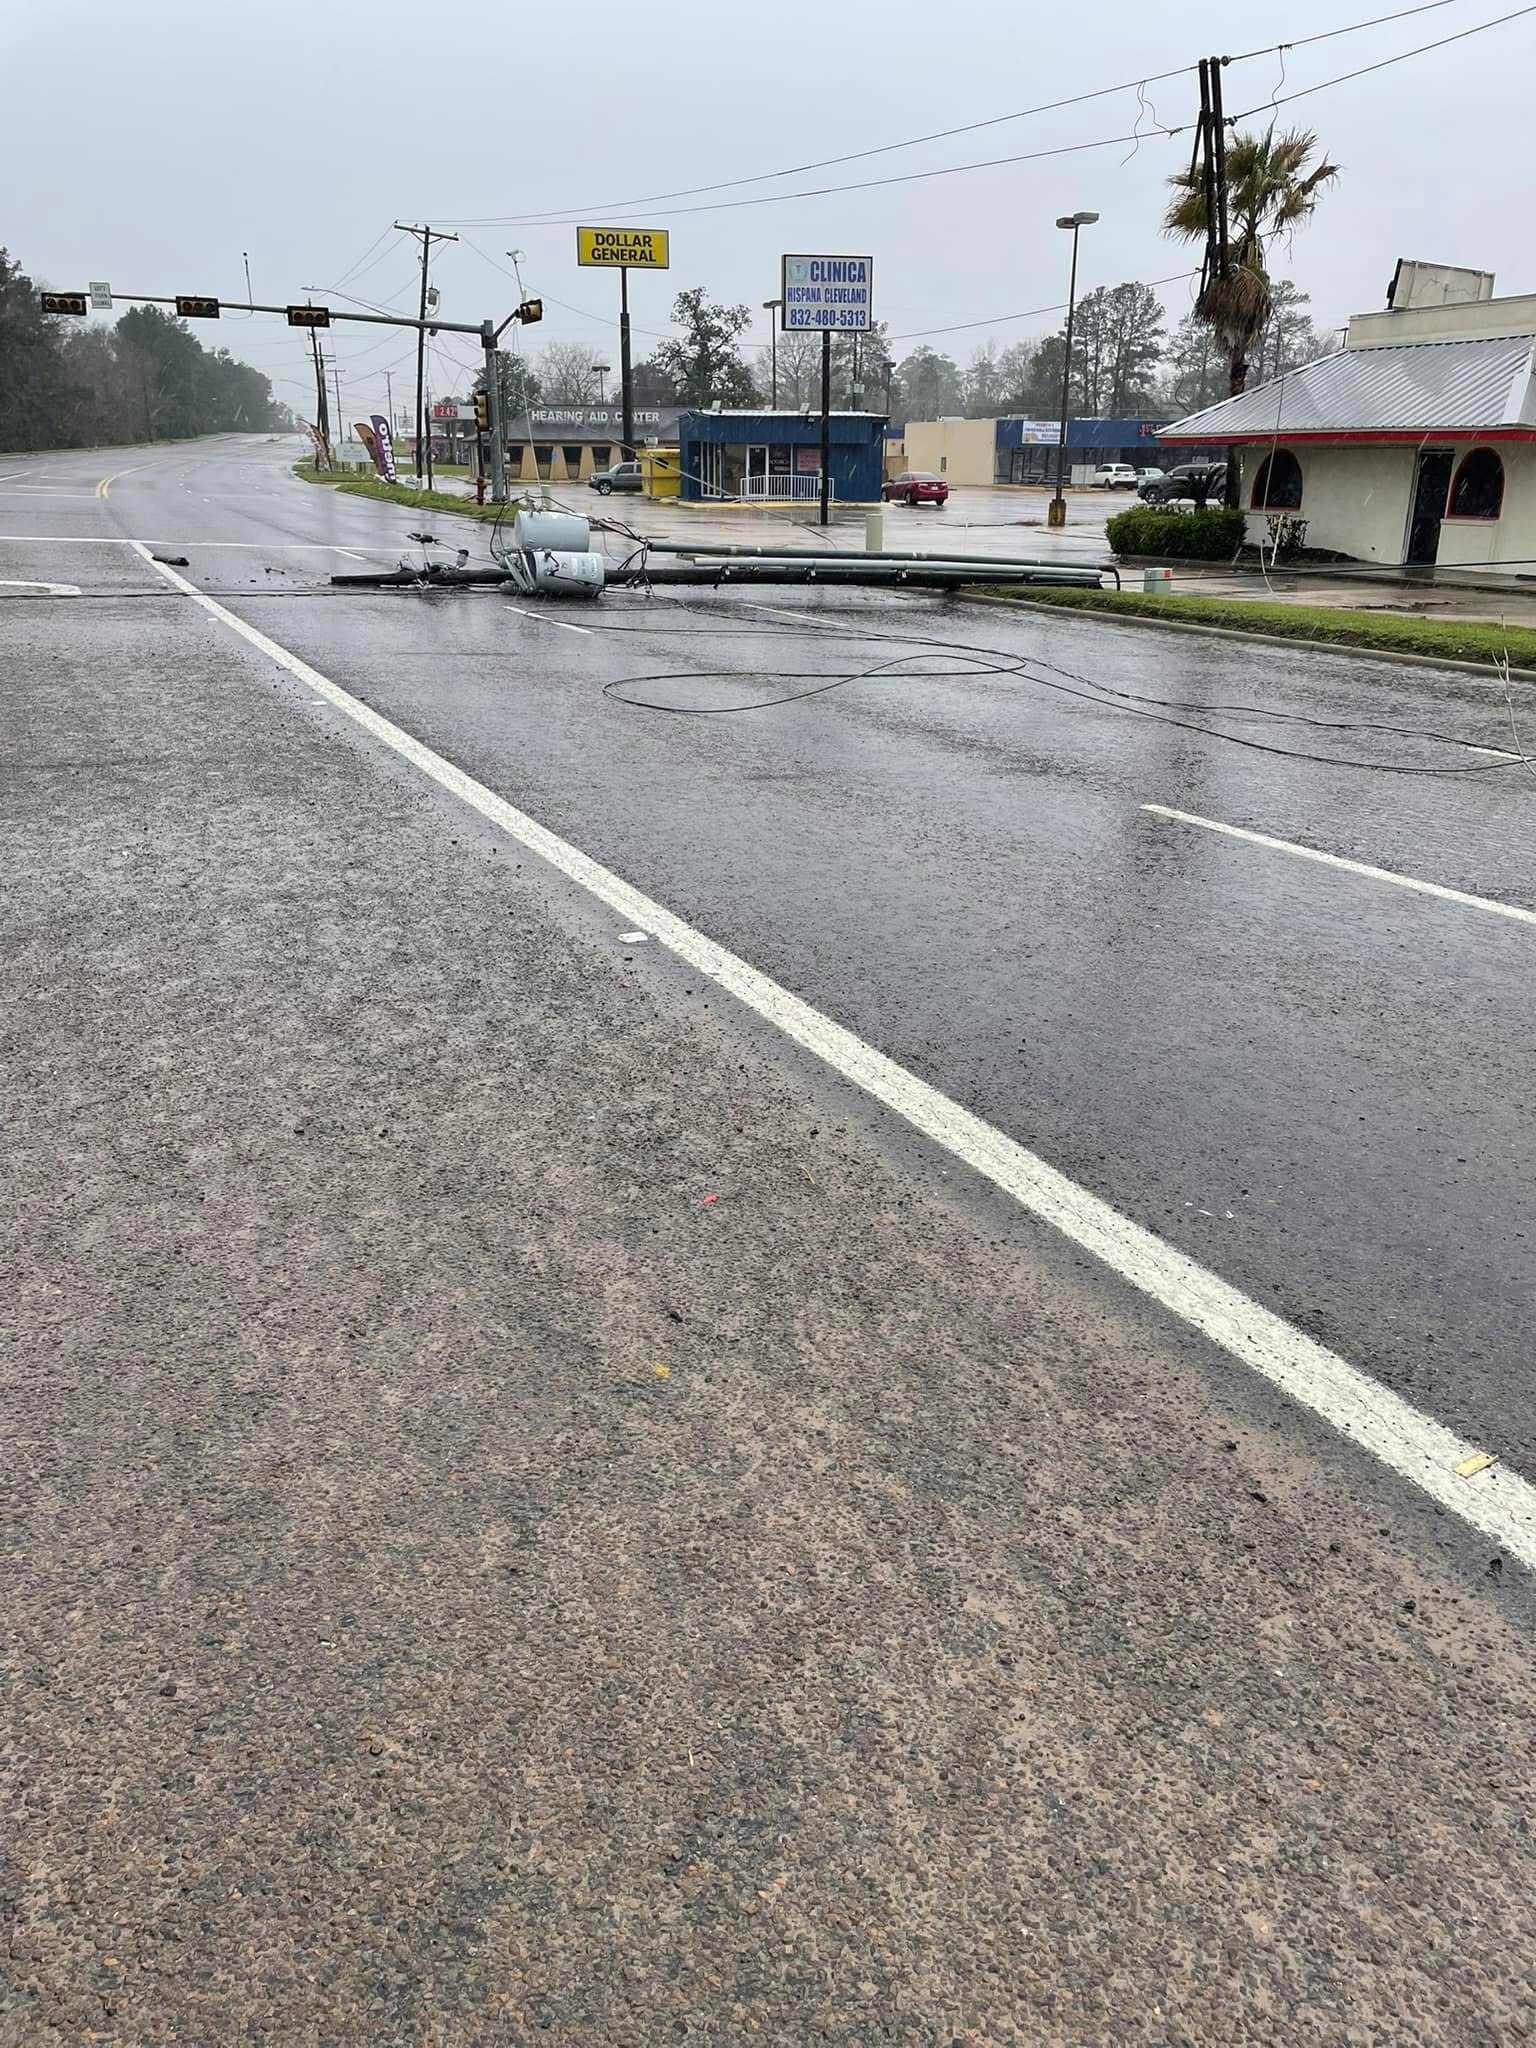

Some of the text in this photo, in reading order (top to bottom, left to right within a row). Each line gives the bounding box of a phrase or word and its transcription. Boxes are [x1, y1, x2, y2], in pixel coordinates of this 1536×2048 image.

[594, 233, 653, 248] DOLLAR
[591, 248, 657, 263] GENERAL
[810, 260, 867, 283] CLINICA
[787, 287, 867, 304] HISPANA CLEVELAND
[790, 309, 866, 327] 832-480-5313
[531, 410, 660, 423] HEARING AID CNTER
